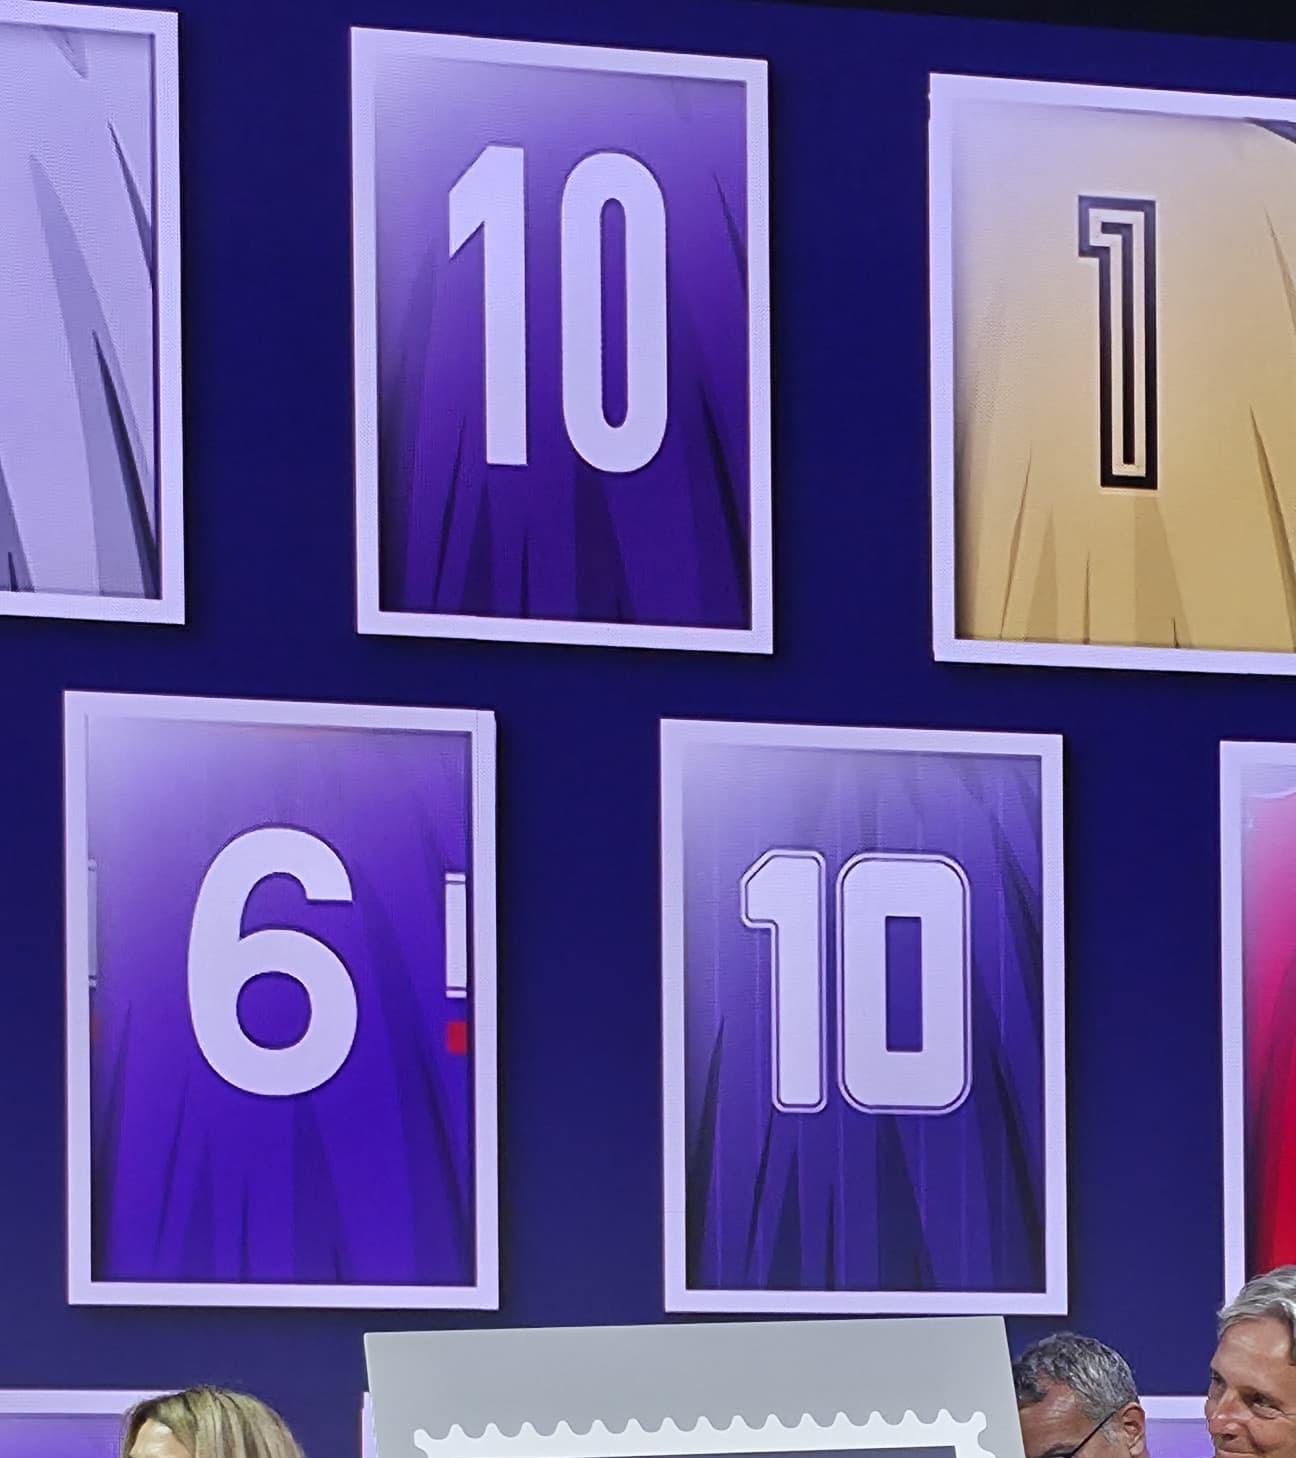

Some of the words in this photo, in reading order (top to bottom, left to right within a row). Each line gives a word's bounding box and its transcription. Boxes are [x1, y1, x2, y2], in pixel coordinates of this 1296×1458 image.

[448, 146, 668, 474] 10
[1077, 195, 1158, 491] 1
[188, 828, 358, 1097] 6
[740, 849, 972, 1114] 10
